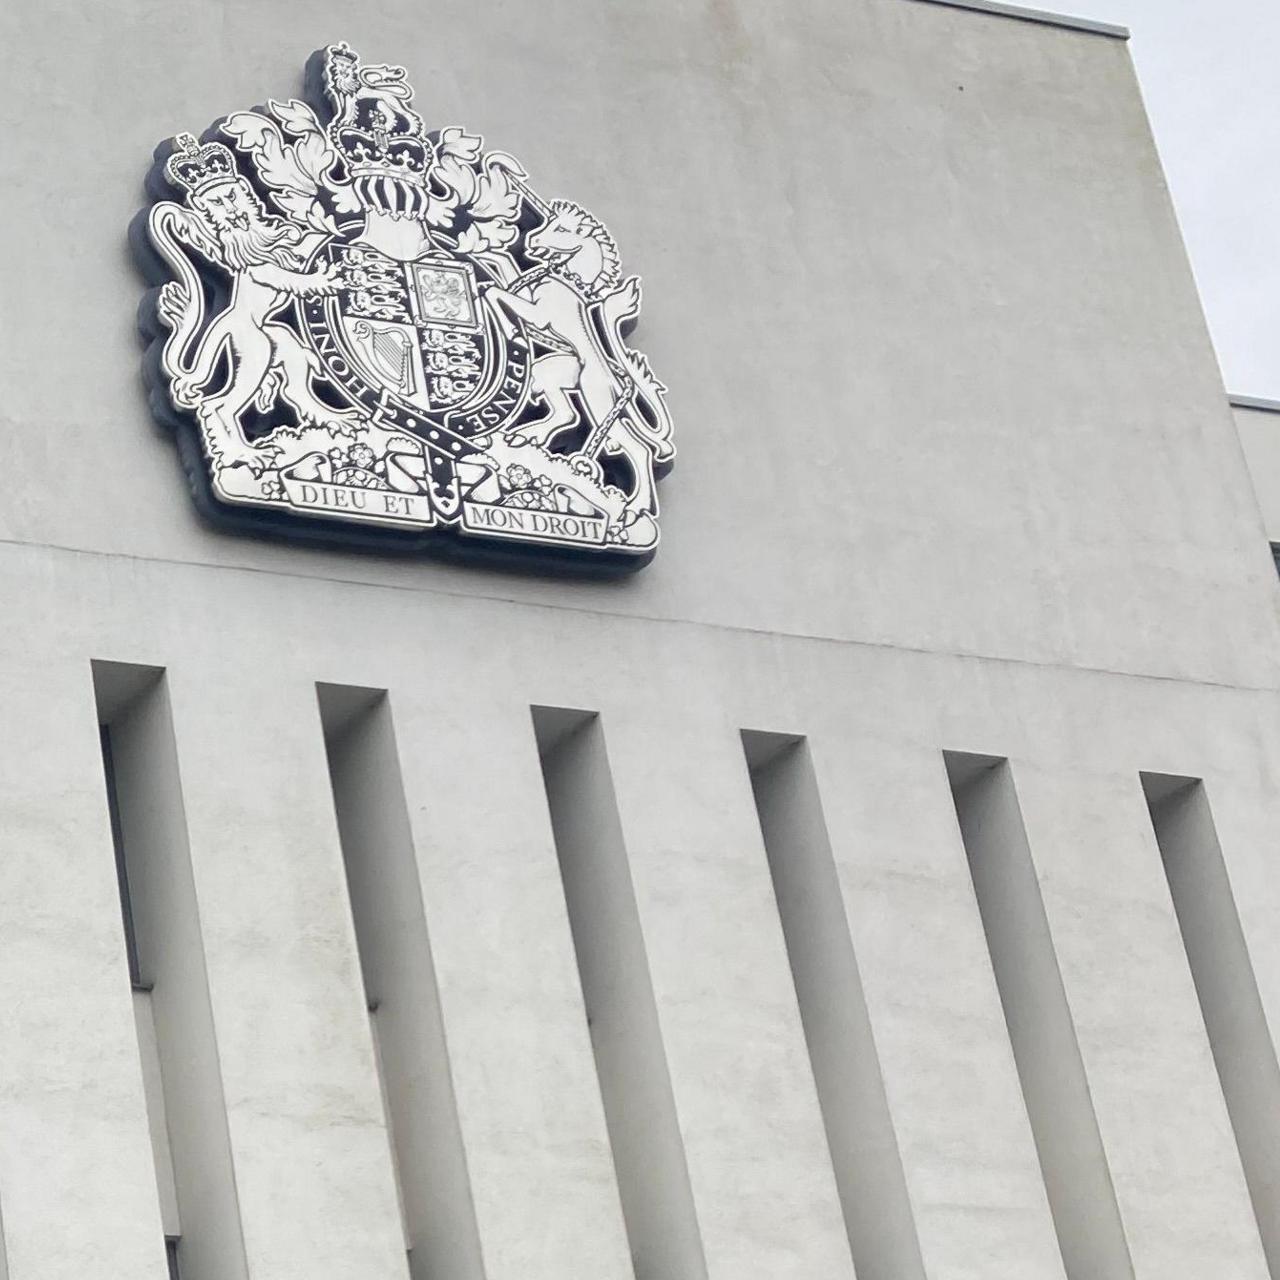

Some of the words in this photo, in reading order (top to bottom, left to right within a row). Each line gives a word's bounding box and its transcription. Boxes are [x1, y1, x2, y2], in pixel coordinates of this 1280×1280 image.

[466, 360, 525, 432] PENSE
[300, 484, 367, 509] DIEU
[384, 494, 415, 516] ET
[471, 506, 525, 531] MON
[530, 511, 602, 540] DROIT
